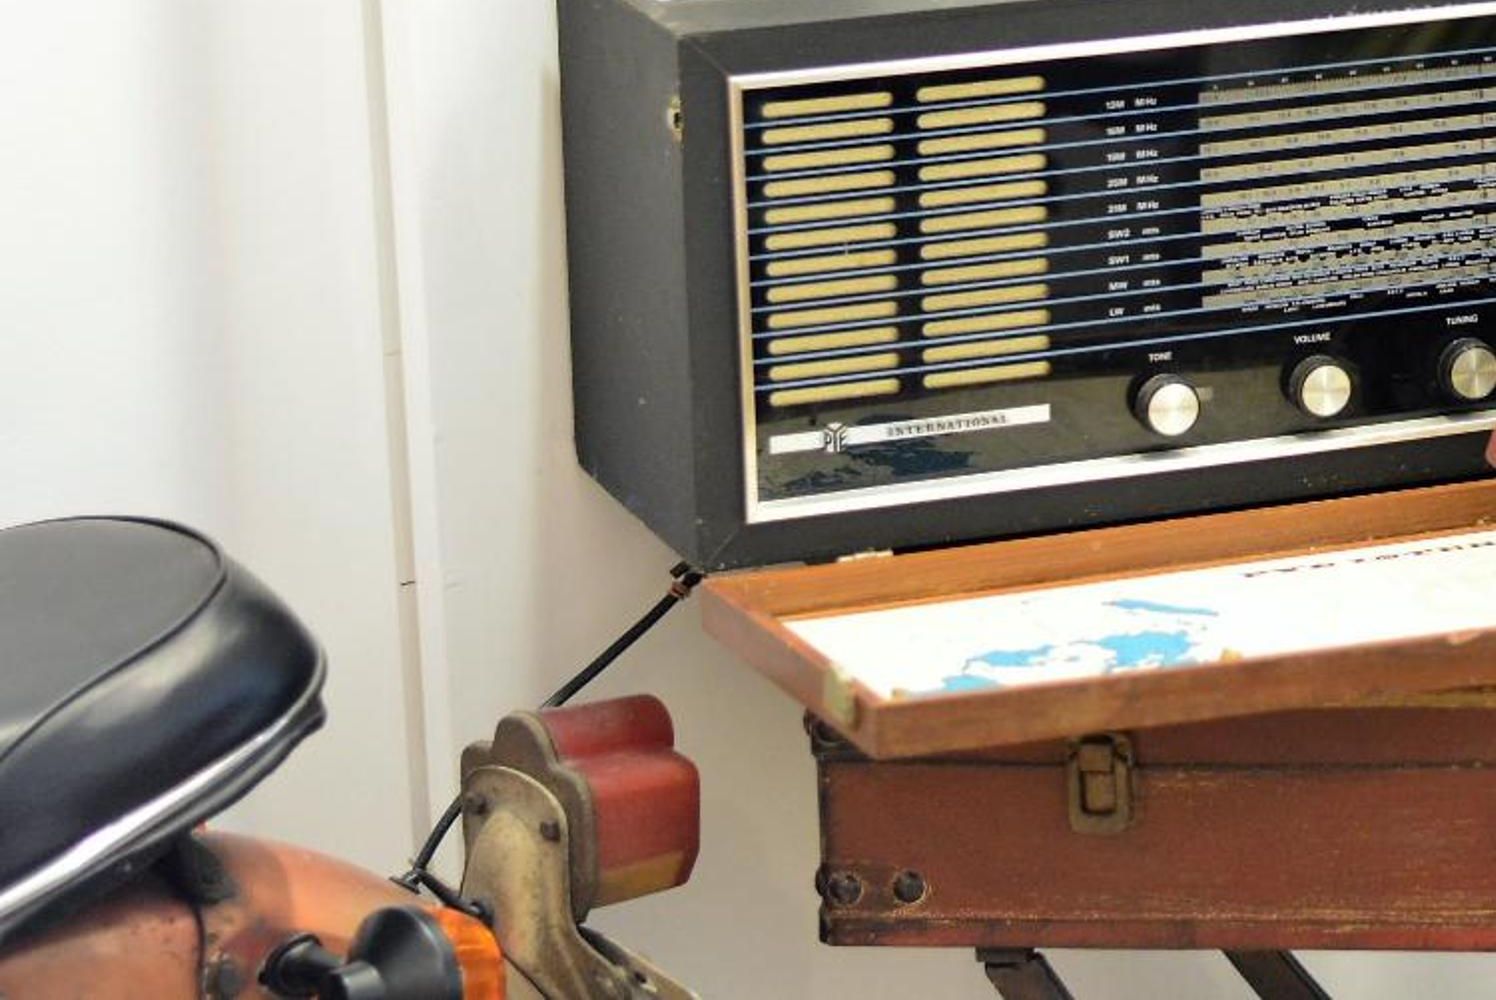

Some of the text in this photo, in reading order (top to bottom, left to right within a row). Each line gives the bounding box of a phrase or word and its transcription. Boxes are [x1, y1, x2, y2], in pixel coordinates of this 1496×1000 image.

[1109, 307, 1125, 317] LW
[1446, 313, 1478, 325] TUNING
[1293, 331, 1331, 344] VOLUME
[1148, 351, 1173, 362] TONE
[887, 414, 1007, 438] INTERNATIONAL
